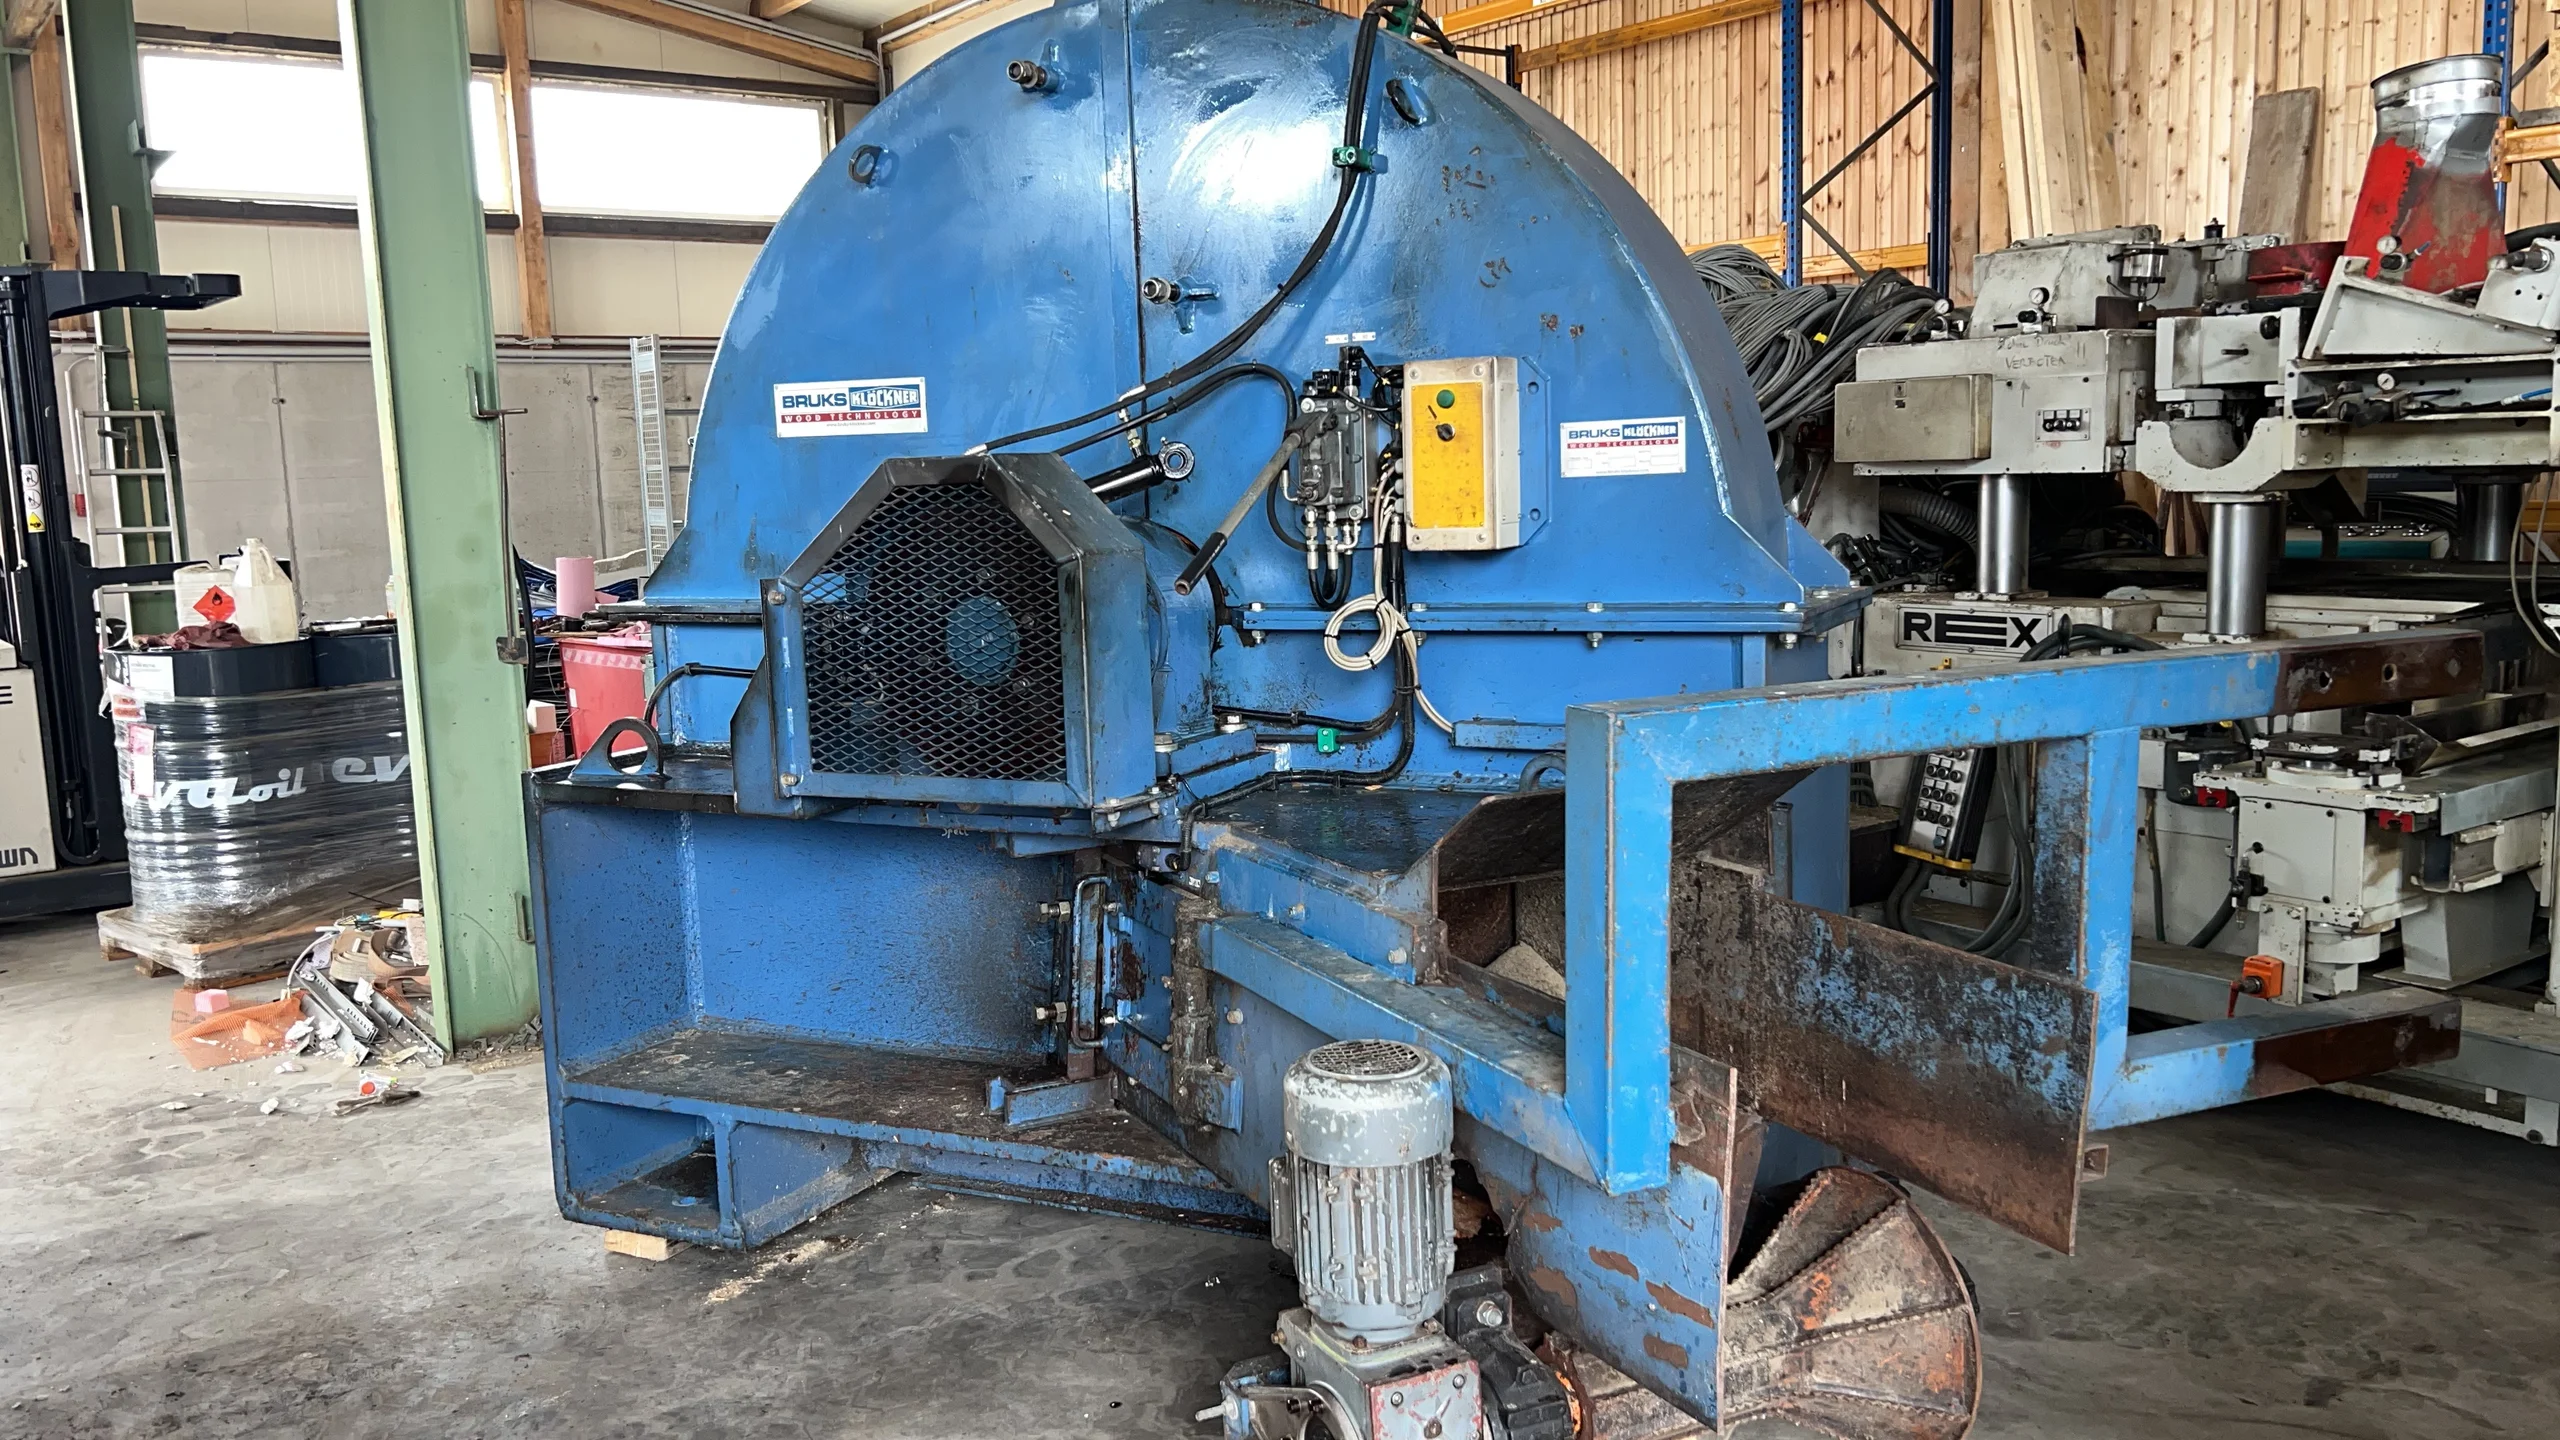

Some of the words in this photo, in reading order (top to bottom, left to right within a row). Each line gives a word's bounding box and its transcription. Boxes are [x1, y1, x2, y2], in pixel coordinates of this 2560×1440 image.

[782, 393, 847, 408] BRUKS
[851, 389, 918, 407] KLÖCKNER
[784, 414, 822, 423] WOOD
[830, 410, 918, 421] TECHNOLOGY
[1568, 428, 1620, 439] BRUKS
[1624, 425, 1677, 437] KLÖCKNER
[1606, 439, 1676, 447] TECHNOLOGY
[1903, 611, 2042, 648] REX
